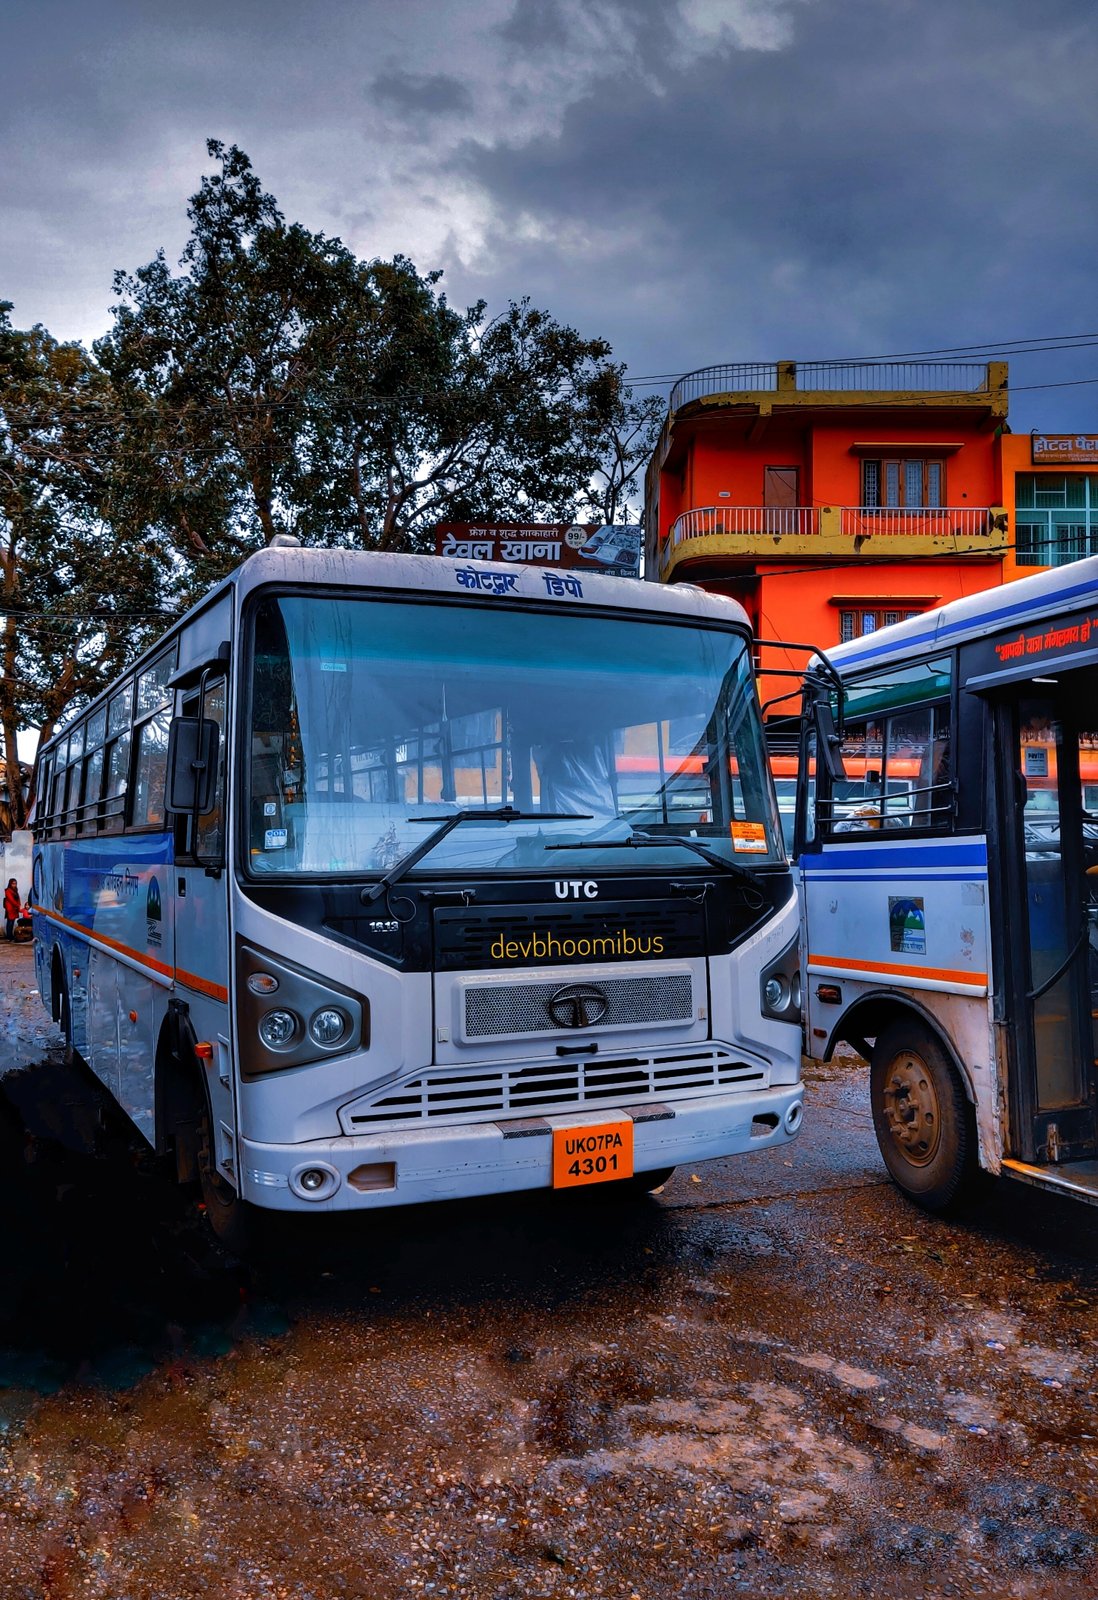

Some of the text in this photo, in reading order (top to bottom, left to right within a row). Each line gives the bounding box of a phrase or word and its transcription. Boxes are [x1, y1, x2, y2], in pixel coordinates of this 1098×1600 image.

[520, 528, 559, 537] शाकाहारी
[568, 532, 585, 540] 99/-
[500, 541, 562, 561] खाना
[542, 572, 583, 598] डिपो
[555, 881, 598, 899] UTC
[490, 928, 664, 959] devbhoomibus
[568, 1153, 618, 1176] 4301
